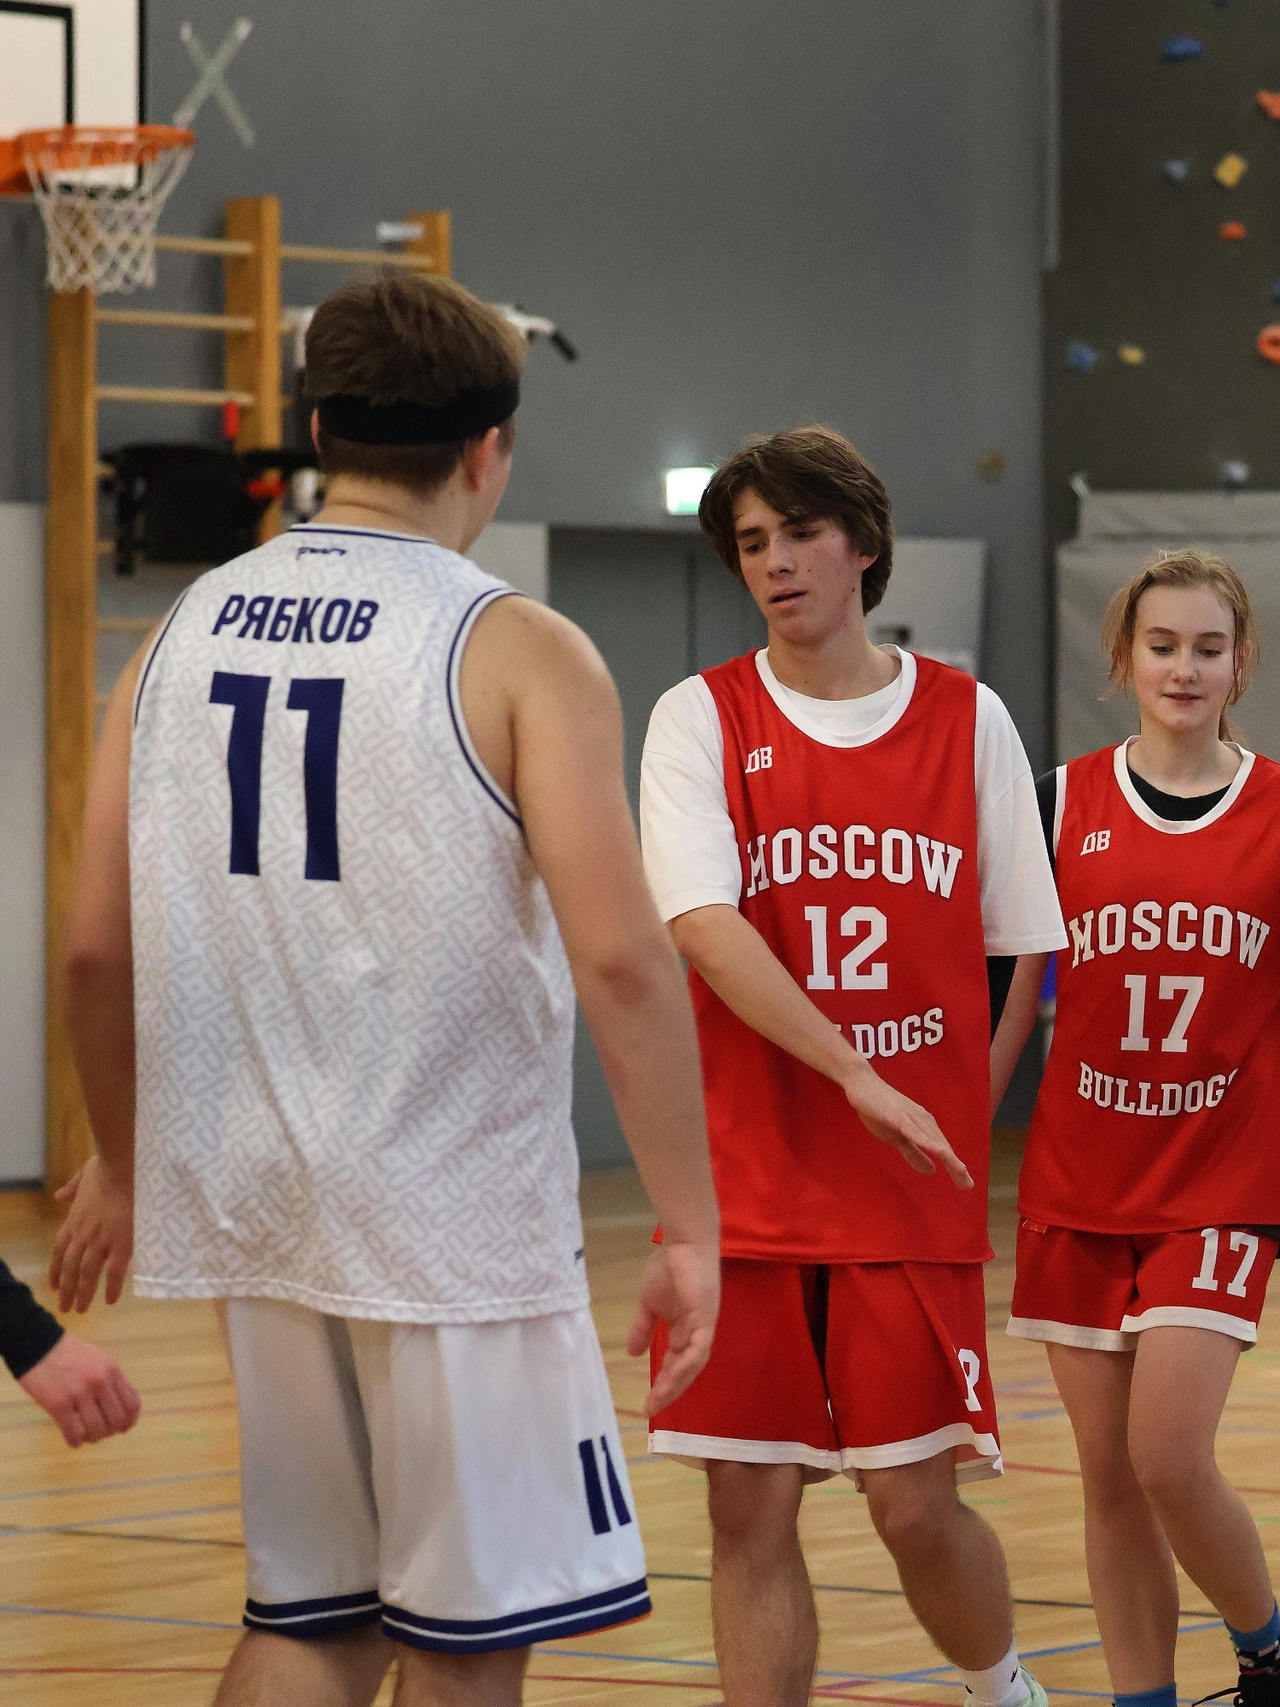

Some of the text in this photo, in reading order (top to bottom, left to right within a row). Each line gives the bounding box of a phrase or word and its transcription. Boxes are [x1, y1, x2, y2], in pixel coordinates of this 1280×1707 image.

[211, 594, 380, 644] РЯБКОВ
[209, 671, 345, 881] 11
[745, 824, 963, 899] MOSCOW
[804, 905, 889, 990] 12
[1068, 900, 1271, 970] MOSCOW
[838, 1006, 944, 1059] DOGS
[1120, 974, 1205, 1053] 17
[1192, 1227, 1259, 1298] 17
